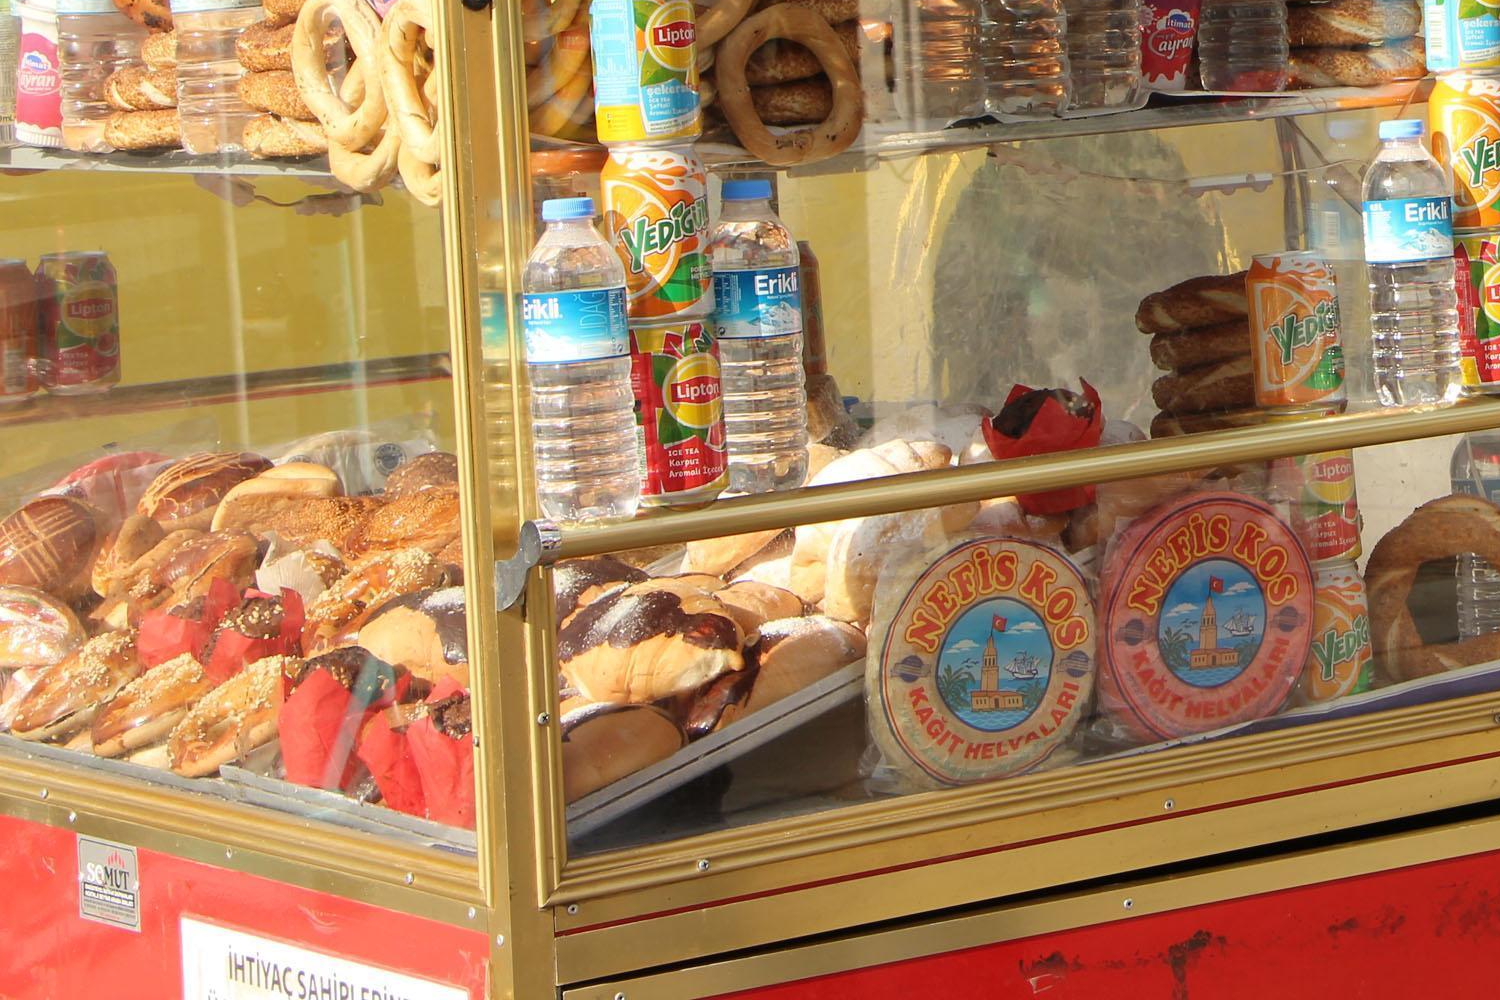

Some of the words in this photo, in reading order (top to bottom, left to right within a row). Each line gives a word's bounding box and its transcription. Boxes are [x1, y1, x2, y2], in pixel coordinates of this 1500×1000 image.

[658, 28, 695, 44] Lipton
[1405, 201, 1448, 222] Erikli
[754, 272, 797, 296] Erikli
[676, 382, 720, 401] Lipton
[1316, 462, 1352, 479] Lipton
[1128, 512, 1231, 616] NEFİS
[1232, 522, 1298, 606] KOS
[905, 547, 1018, 653] NEFİS
[1018, 559, 1089, 651] KOS
[1132, 649, 1184, 712] KAĞIT
[1183, 637, 1290, 719] HELVALARI
[908, 686, 966, 753] KAĞIT
[963, 681, 1081, 761] HELVALARI
[86, 862, 129, 890] SOMUT
[228, 945, 293, 1000] İHTİYAÇ
